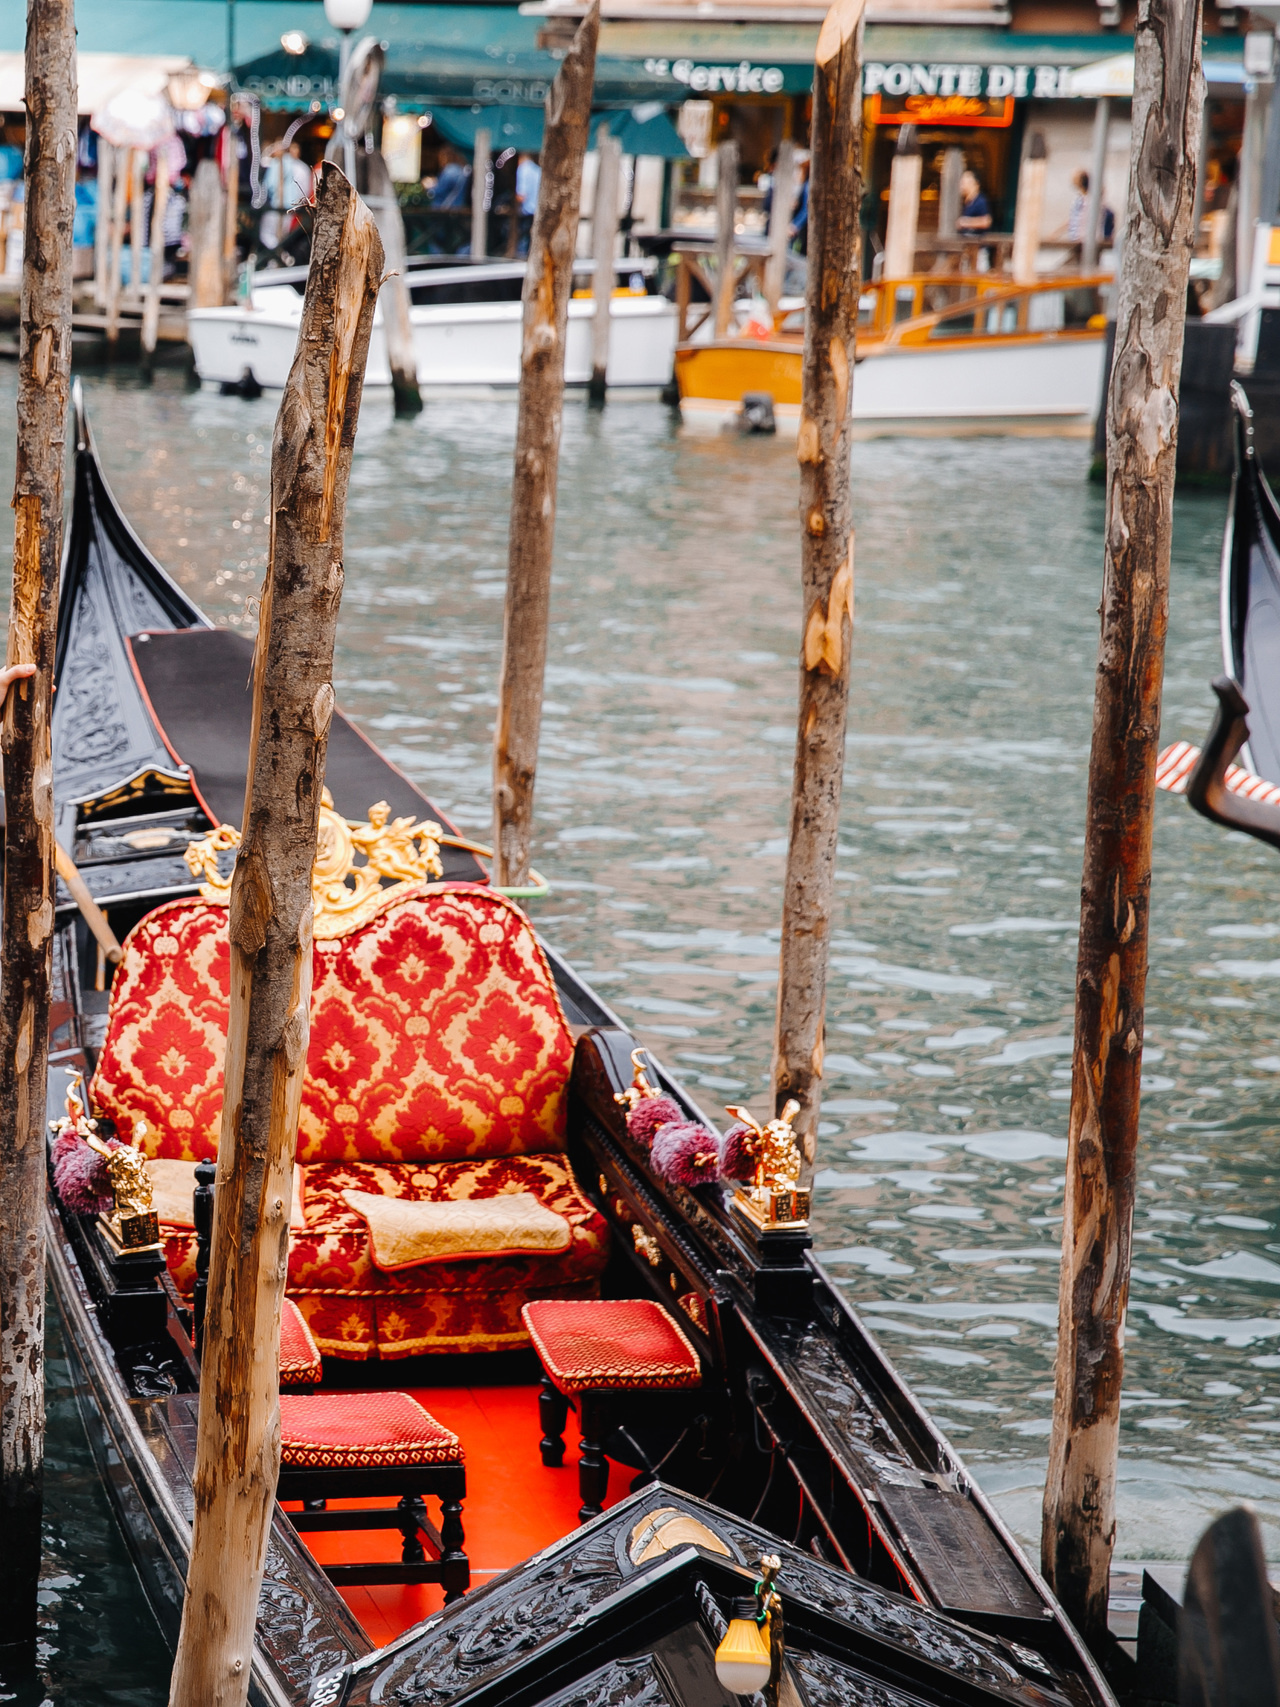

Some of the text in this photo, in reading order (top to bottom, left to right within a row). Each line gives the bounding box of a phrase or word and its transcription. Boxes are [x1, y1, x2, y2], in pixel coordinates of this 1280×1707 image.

[672, 58, 785, 93] Service
[863, 62, 983, 96] PONTE
[985, 64, 1030, 98] DI
